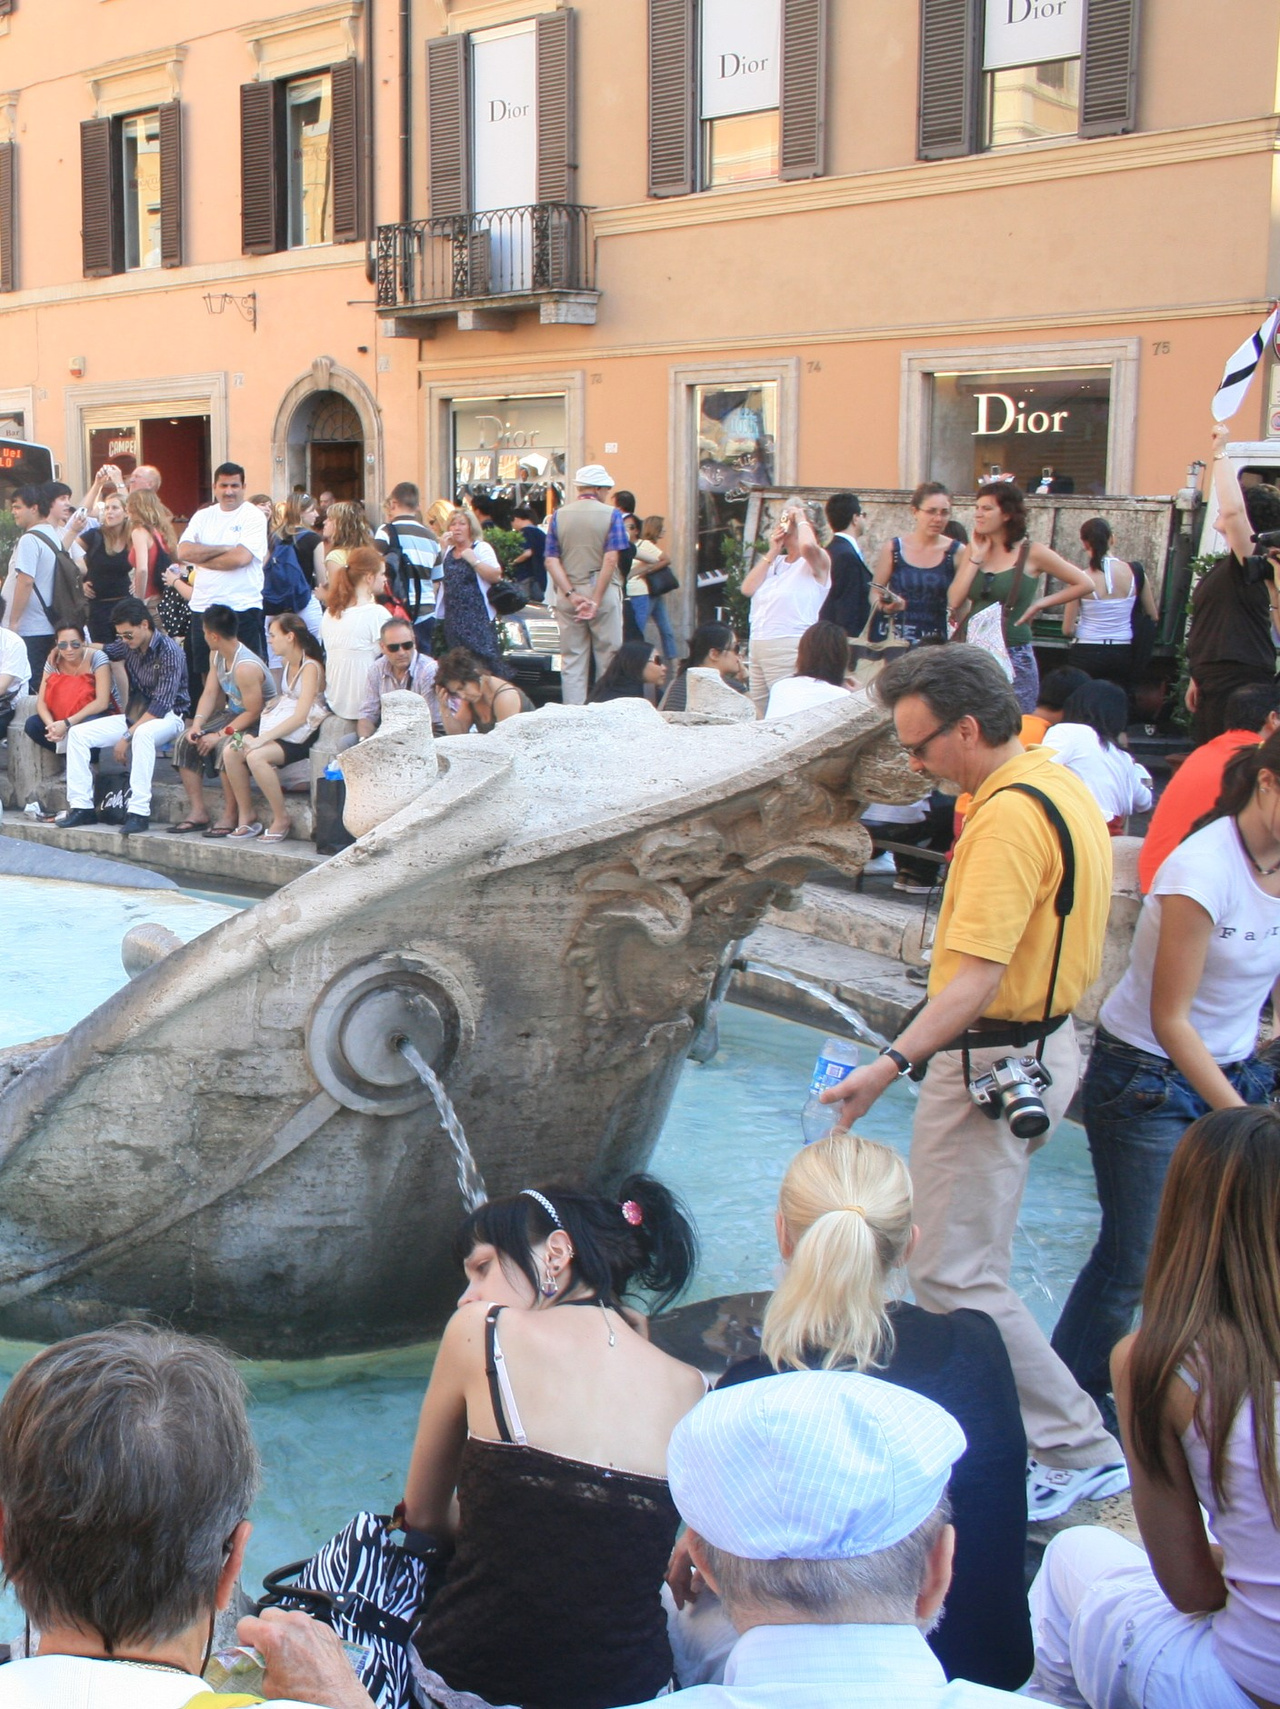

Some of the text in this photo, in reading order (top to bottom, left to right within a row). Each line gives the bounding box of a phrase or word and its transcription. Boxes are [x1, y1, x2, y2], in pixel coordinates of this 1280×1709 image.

[1003, 0, 1067, 25] Dior
[717, 53, 769, 79] Dior
[488, 99, 530, 123] Dior
[1152, 341, 1171, 356] 75
[970, 392, 1070, 436] Dior
[5, 429, 20, 437] Bar
[475, 415, 540, 449] Dior
